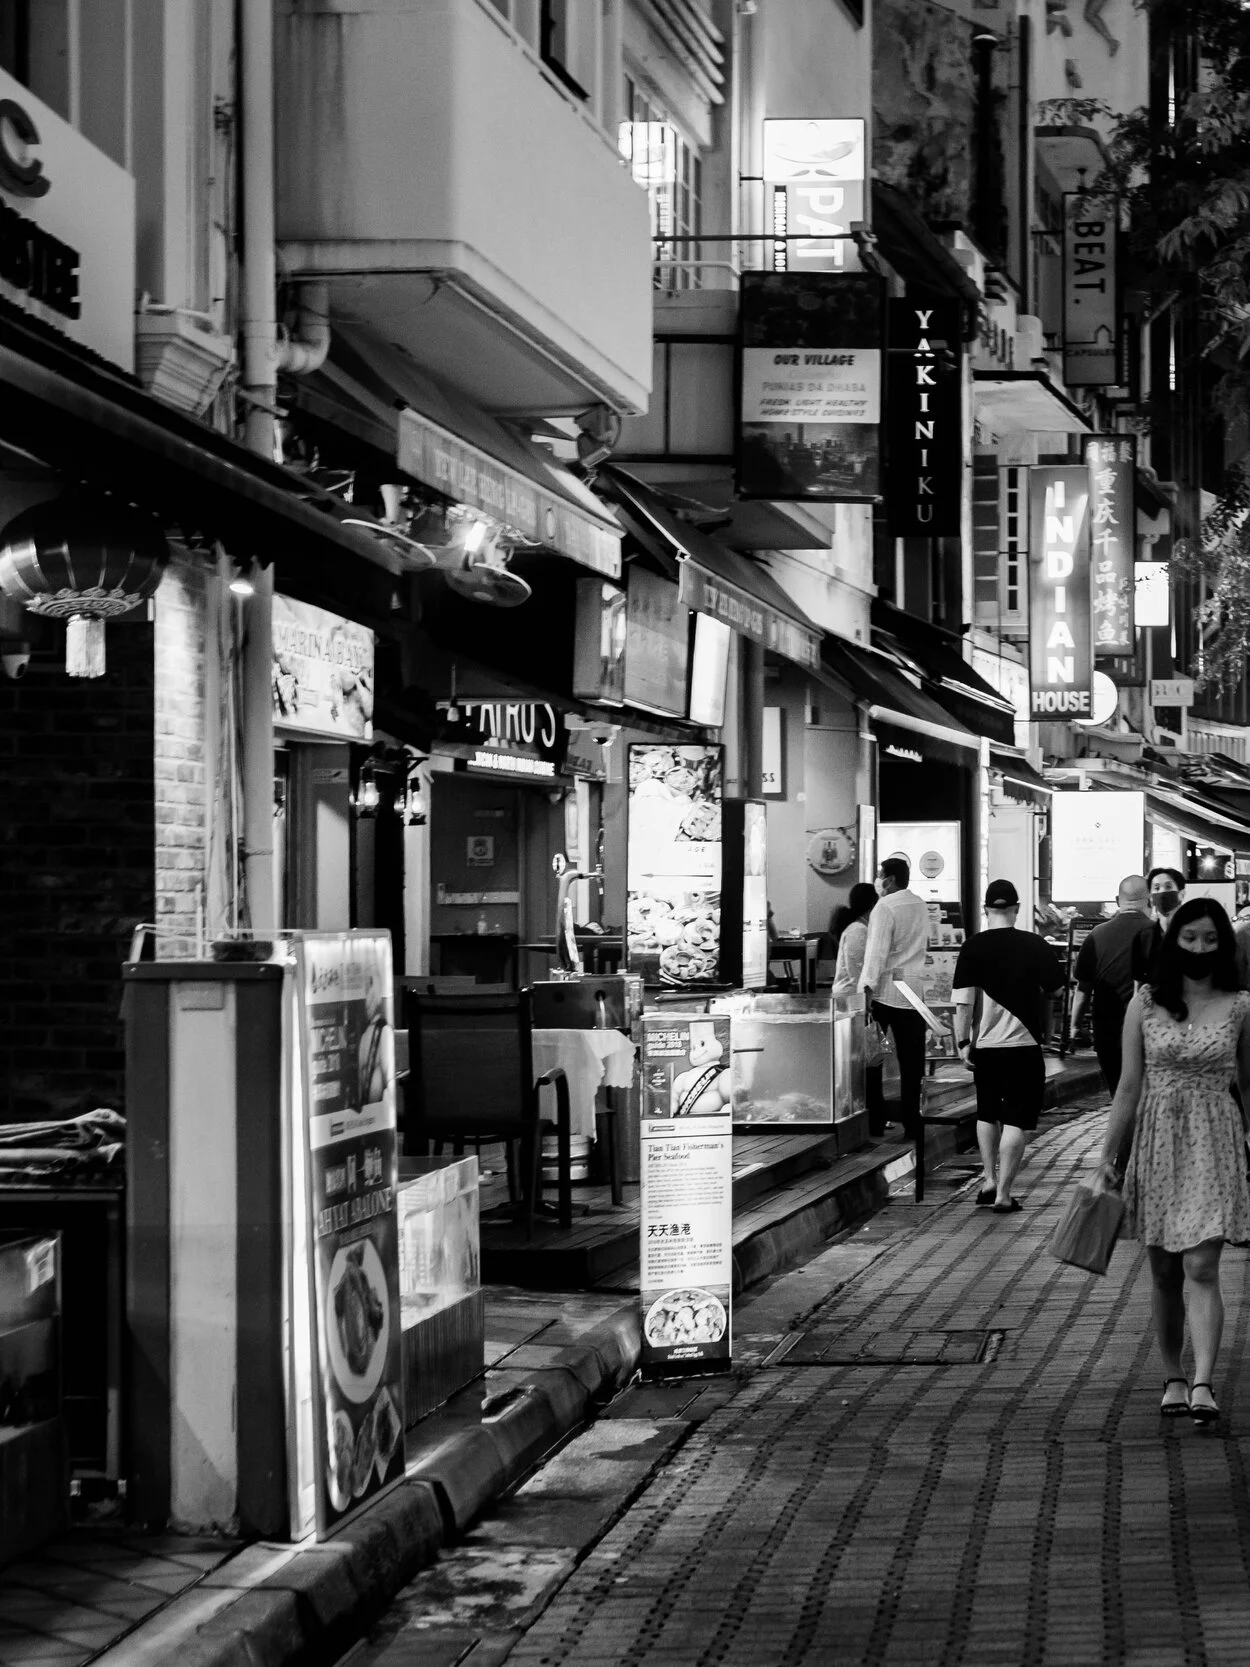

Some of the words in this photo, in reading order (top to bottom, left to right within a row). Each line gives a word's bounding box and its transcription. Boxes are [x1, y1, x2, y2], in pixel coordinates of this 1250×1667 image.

[796, 187, 844, 273] PAT
[773, 354, 800, 366] OUR
[804, 353, 856, 366] VILLAGE
[913, 309, 937, 523] YAKINIKU
[1045, 480, 1076, 684] INDIAN
[1032, 690, 1091, 712] HOUSE
